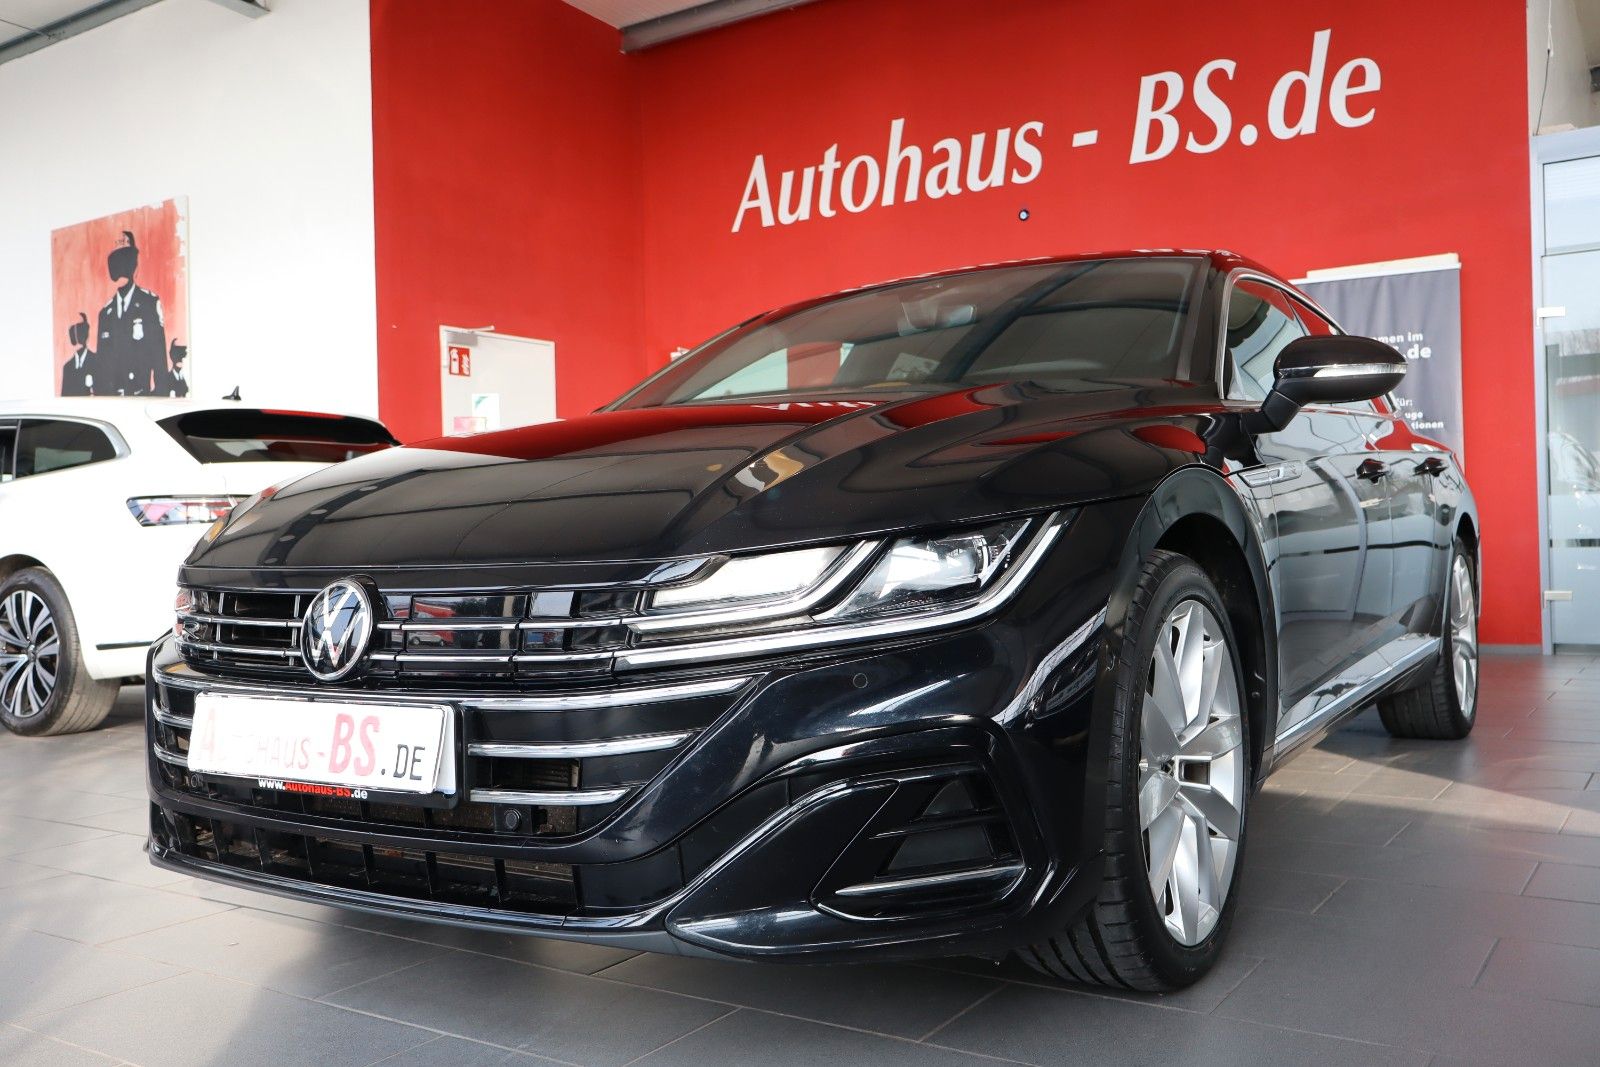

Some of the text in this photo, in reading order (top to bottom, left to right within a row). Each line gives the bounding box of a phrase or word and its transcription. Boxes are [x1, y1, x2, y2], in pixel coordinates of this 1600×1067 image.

[731, 117, 1044, 233] Autohaus
[1129, 28, 1382, 165] BS.de
[1407, 331, 1424, 342] im
